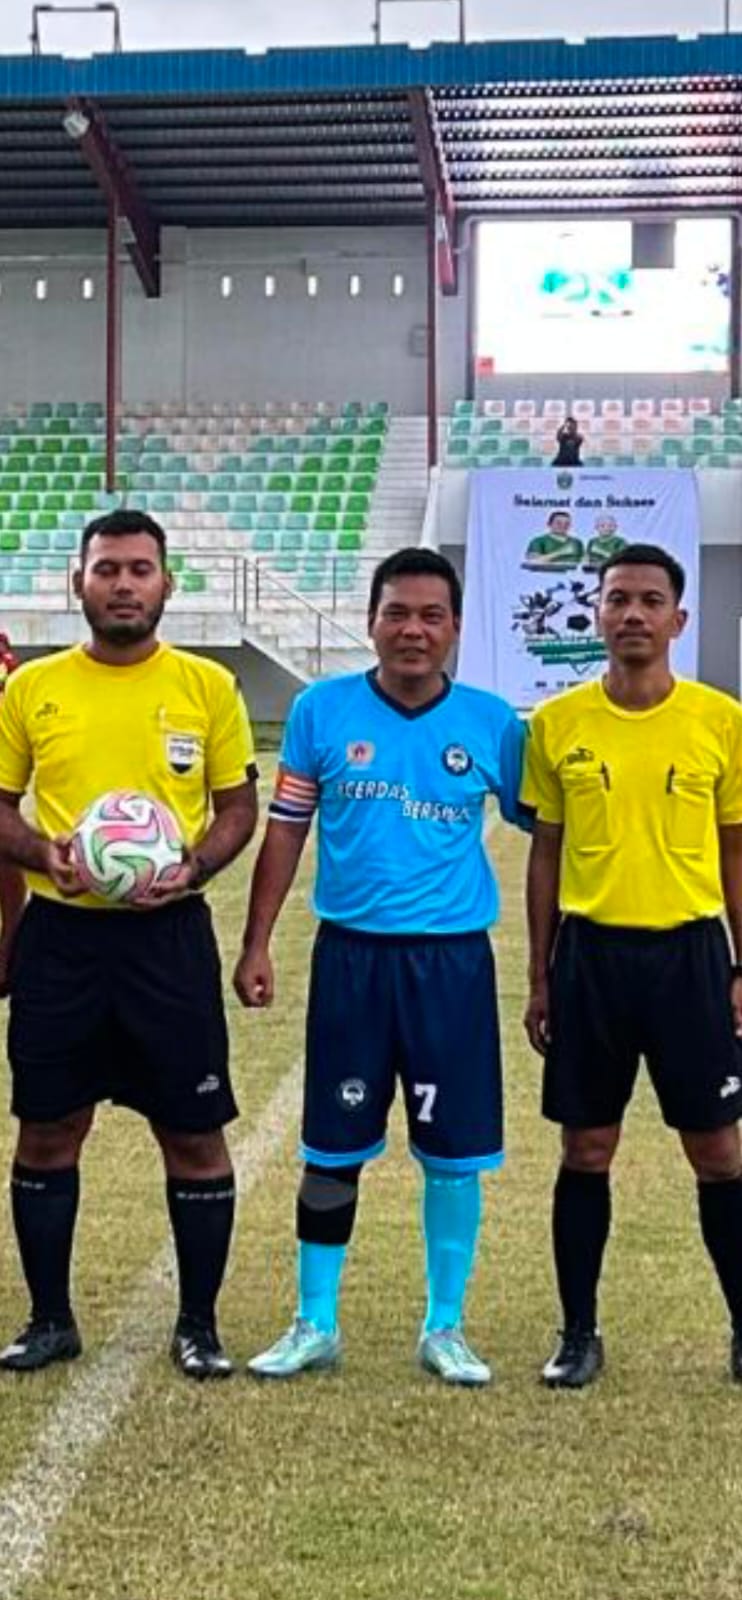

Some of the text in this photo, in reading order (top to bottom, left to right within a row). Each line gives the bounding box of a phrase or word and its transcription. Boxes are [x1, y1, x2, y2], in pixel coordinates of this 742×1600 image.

[514, 494, 570, 506] Selamat
[575, 496, 602, 507] dan
[414, 1083, 437, 1122] 7
